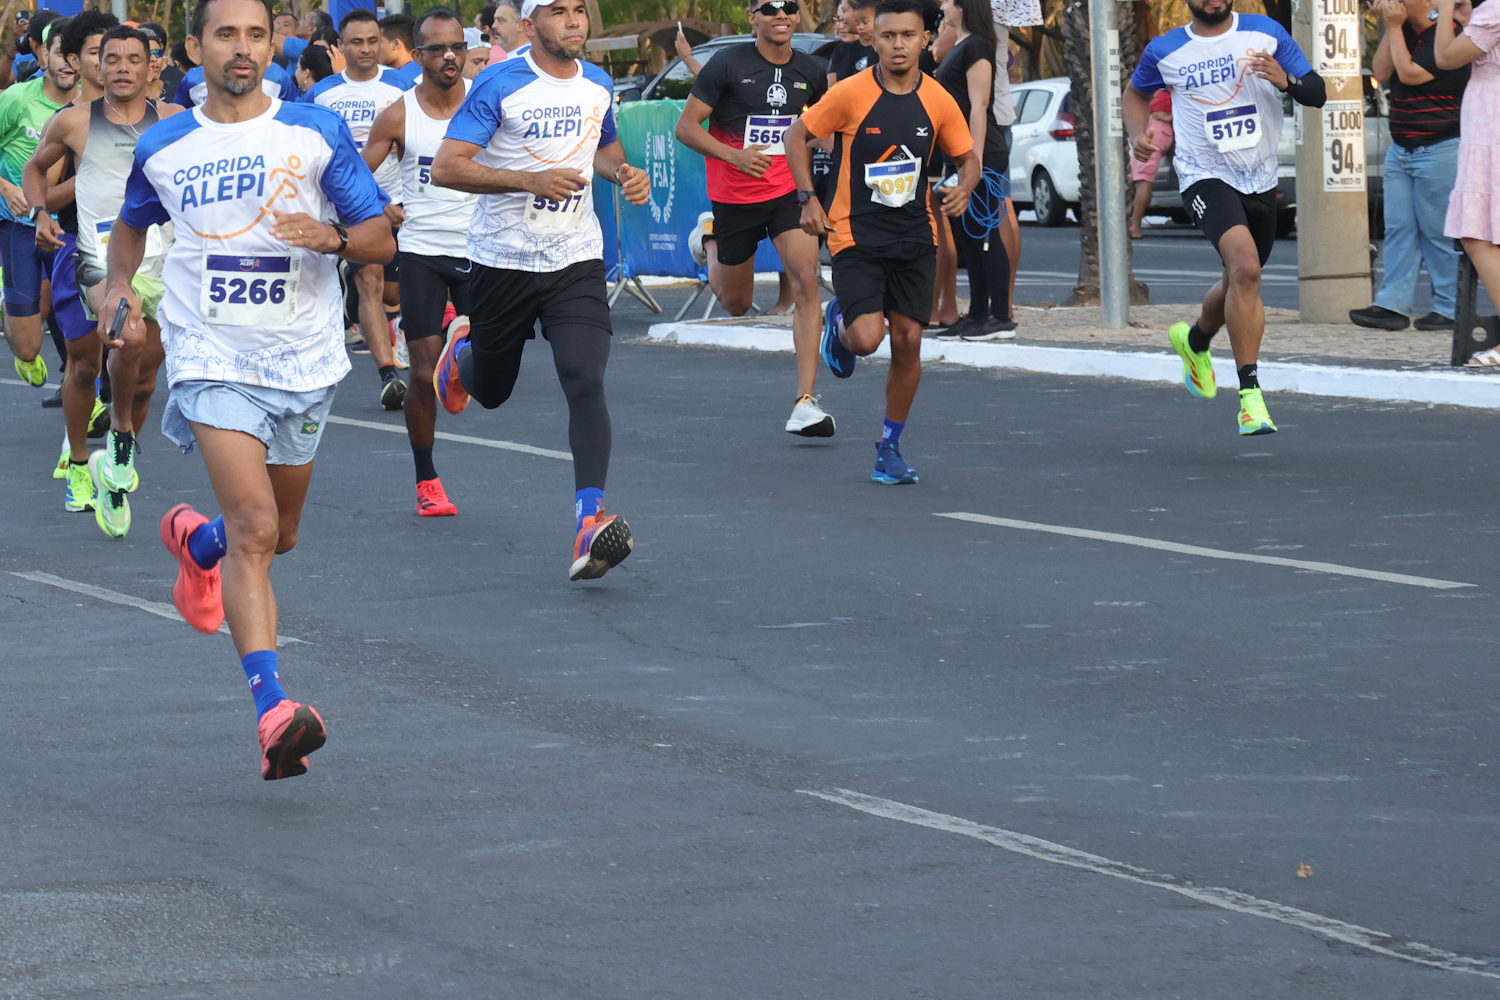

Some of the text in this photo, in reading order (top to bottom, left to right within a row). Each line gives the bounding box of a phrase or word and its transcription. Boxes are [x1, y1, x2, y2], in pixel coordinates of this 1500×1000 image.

[1325, 24, 1348, 59] 94
[1179, 54, 1233, 76] CORRIDA
[1186, 63, 1235, 90] ALEPI
[331, 101, 375, 110] CORRIDA
[522, 105, 582, 121] CORRIDA
[523, 118, 582, 139] ALEPI
[1212, 118, 1256, 140] 5179
[1328, 111, 1361, 130] 1.000
[652, 134, 666, 160] UNI
[749, 128, 786, 144] 565
[1331, 138, 1354, 174] 94
[173, 155, 266, 185] CORRIDA
[652, 162, 669, 188] FSA
[181, 172, 266, 212] ALEPI
[209, 277, 287, 304] 5266
